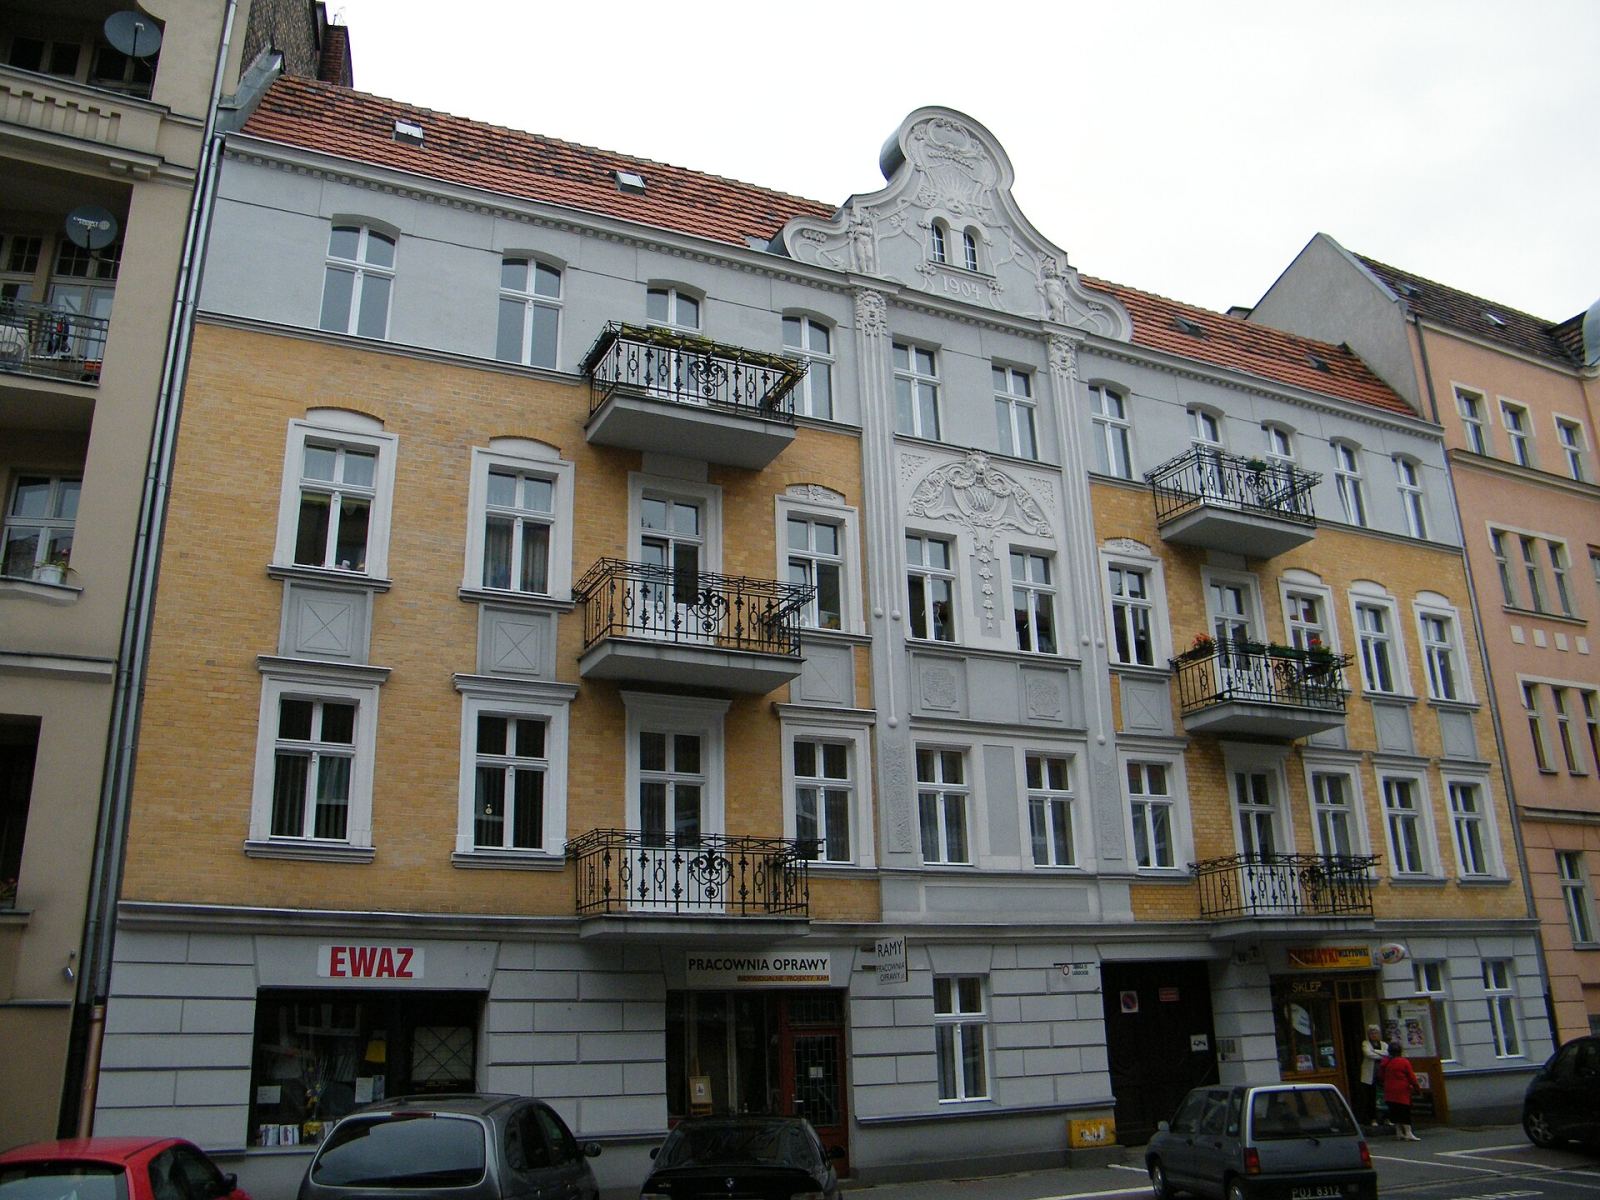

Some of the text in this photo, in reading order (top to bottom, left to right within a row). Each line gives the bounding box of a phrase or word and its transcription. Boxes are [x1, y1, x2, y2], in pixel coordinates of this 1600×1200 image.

[942, 274, 982, 300] 1904
[877, 940, 903, 958] RAMY
[329, 946, 414, 978] EWAZ
[688, 958, 828, 971] PRACOWNIA OPRAWY
[1291, 980, 1322, 993] SKLEP
